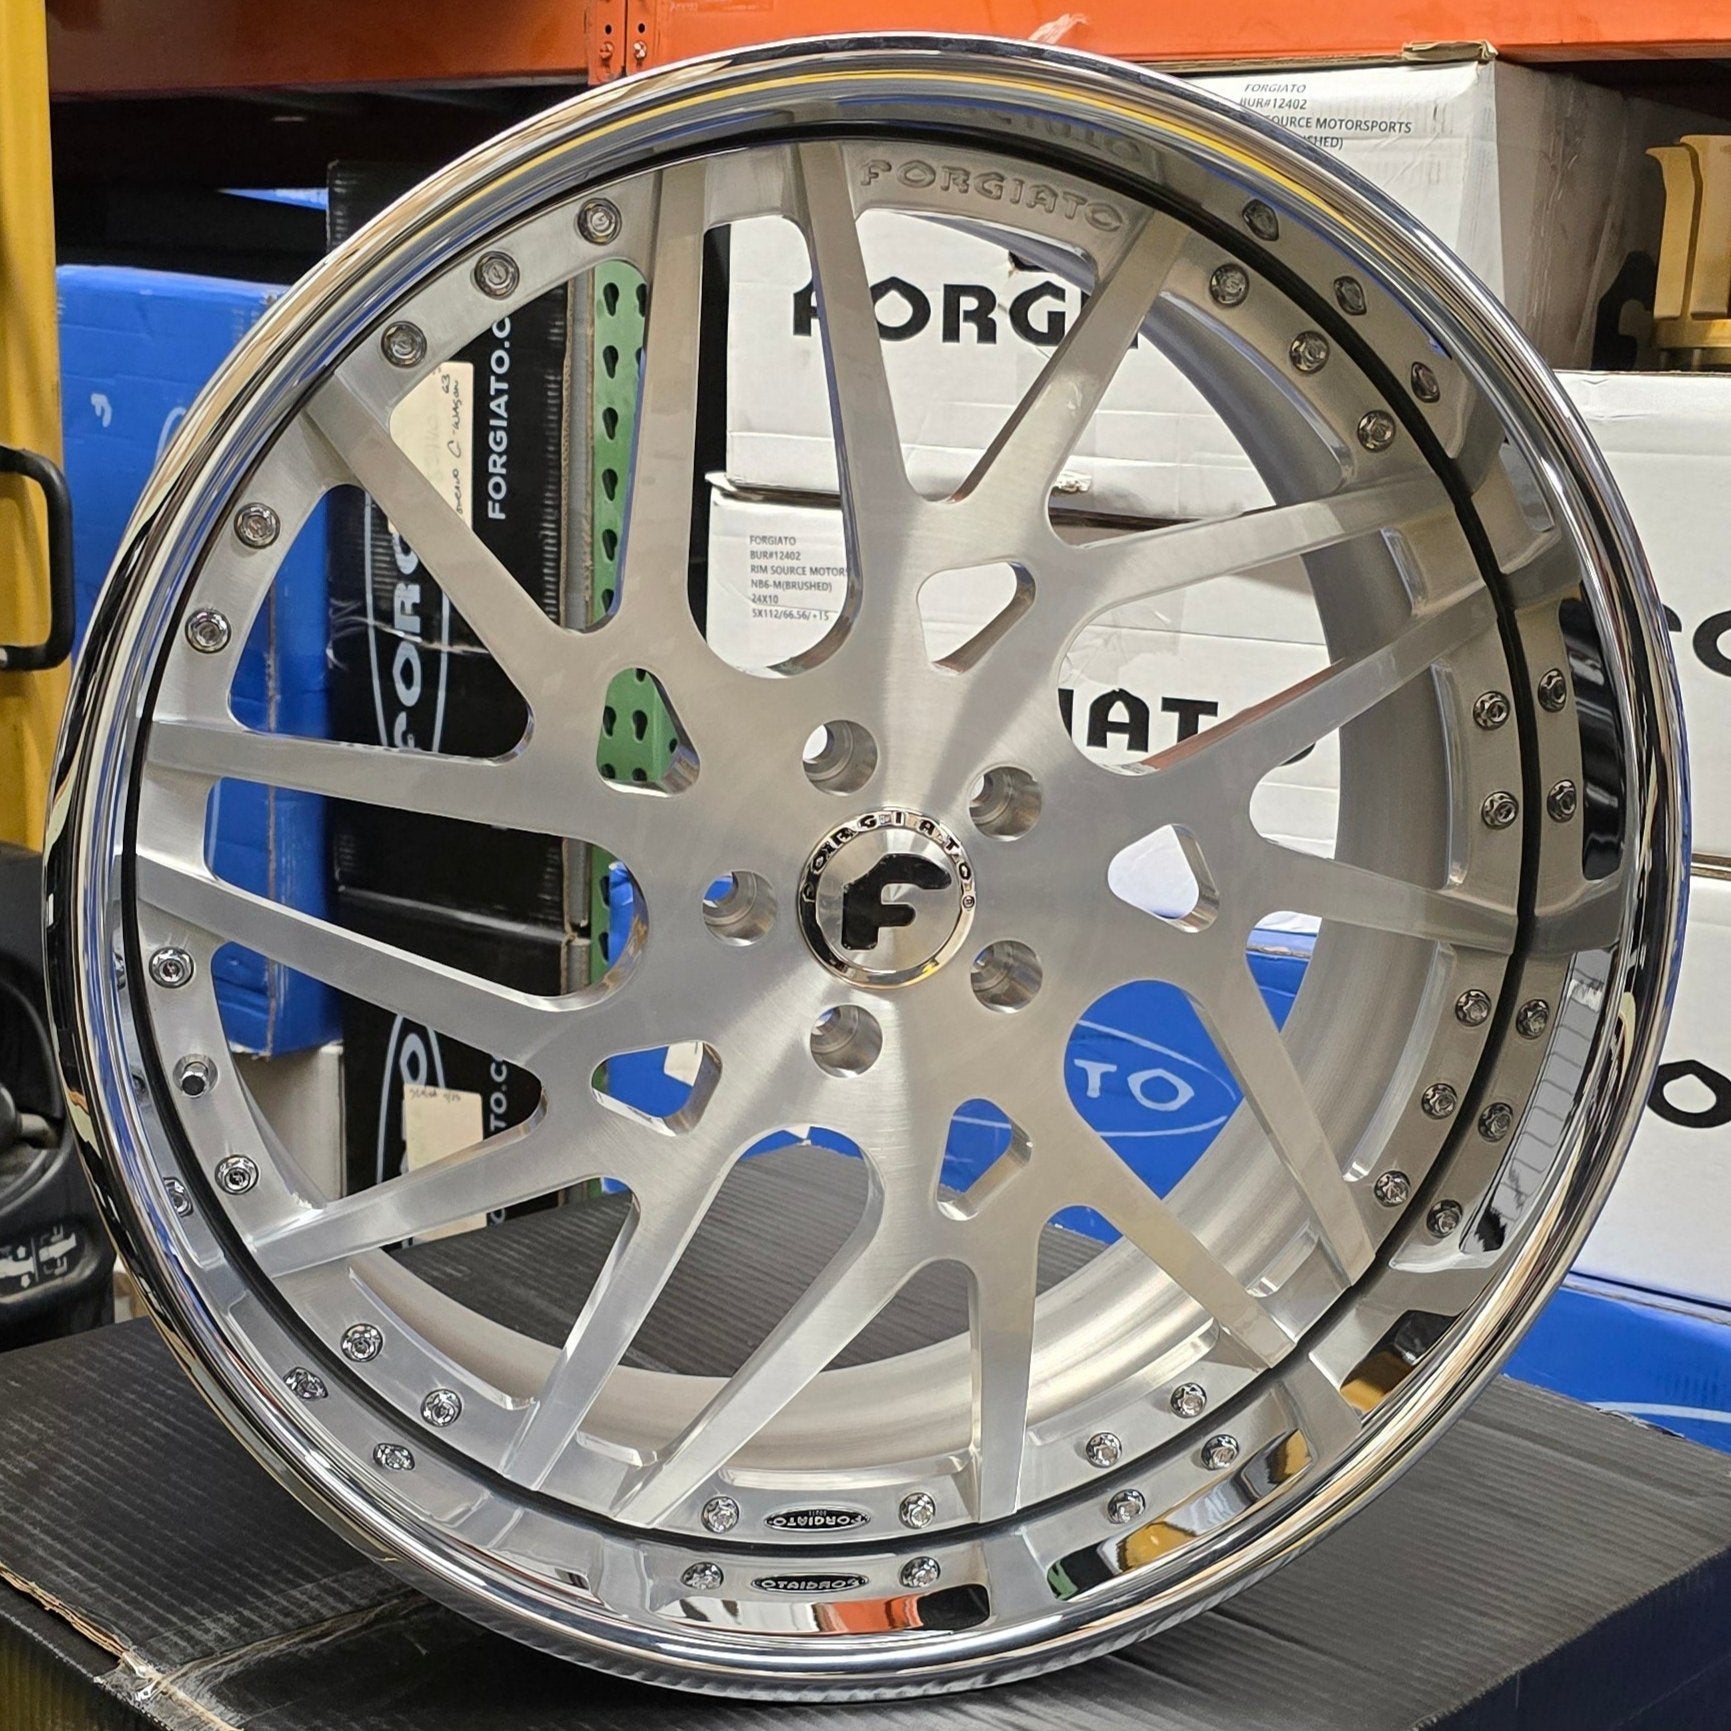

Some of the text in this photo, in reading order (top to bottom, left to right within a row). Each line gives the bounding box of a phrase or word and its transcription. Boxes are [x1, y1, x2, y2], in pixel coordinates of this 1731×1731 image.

[1244, 83, 1306, 94] FORGIATO
[1265, 114, 1412, 133] OURCE MOTORSPORTS
[860, 158, 1124, 233] FORGIATO
[749, 535, 797, 546] FORGIATO
[749, 550, 801, 561] BUR#12402
[750, 564, 768, 575] RIM
[770, 565, 807, 576] SOURCE
[772, 1514, 867, 1527] FORGIATO
